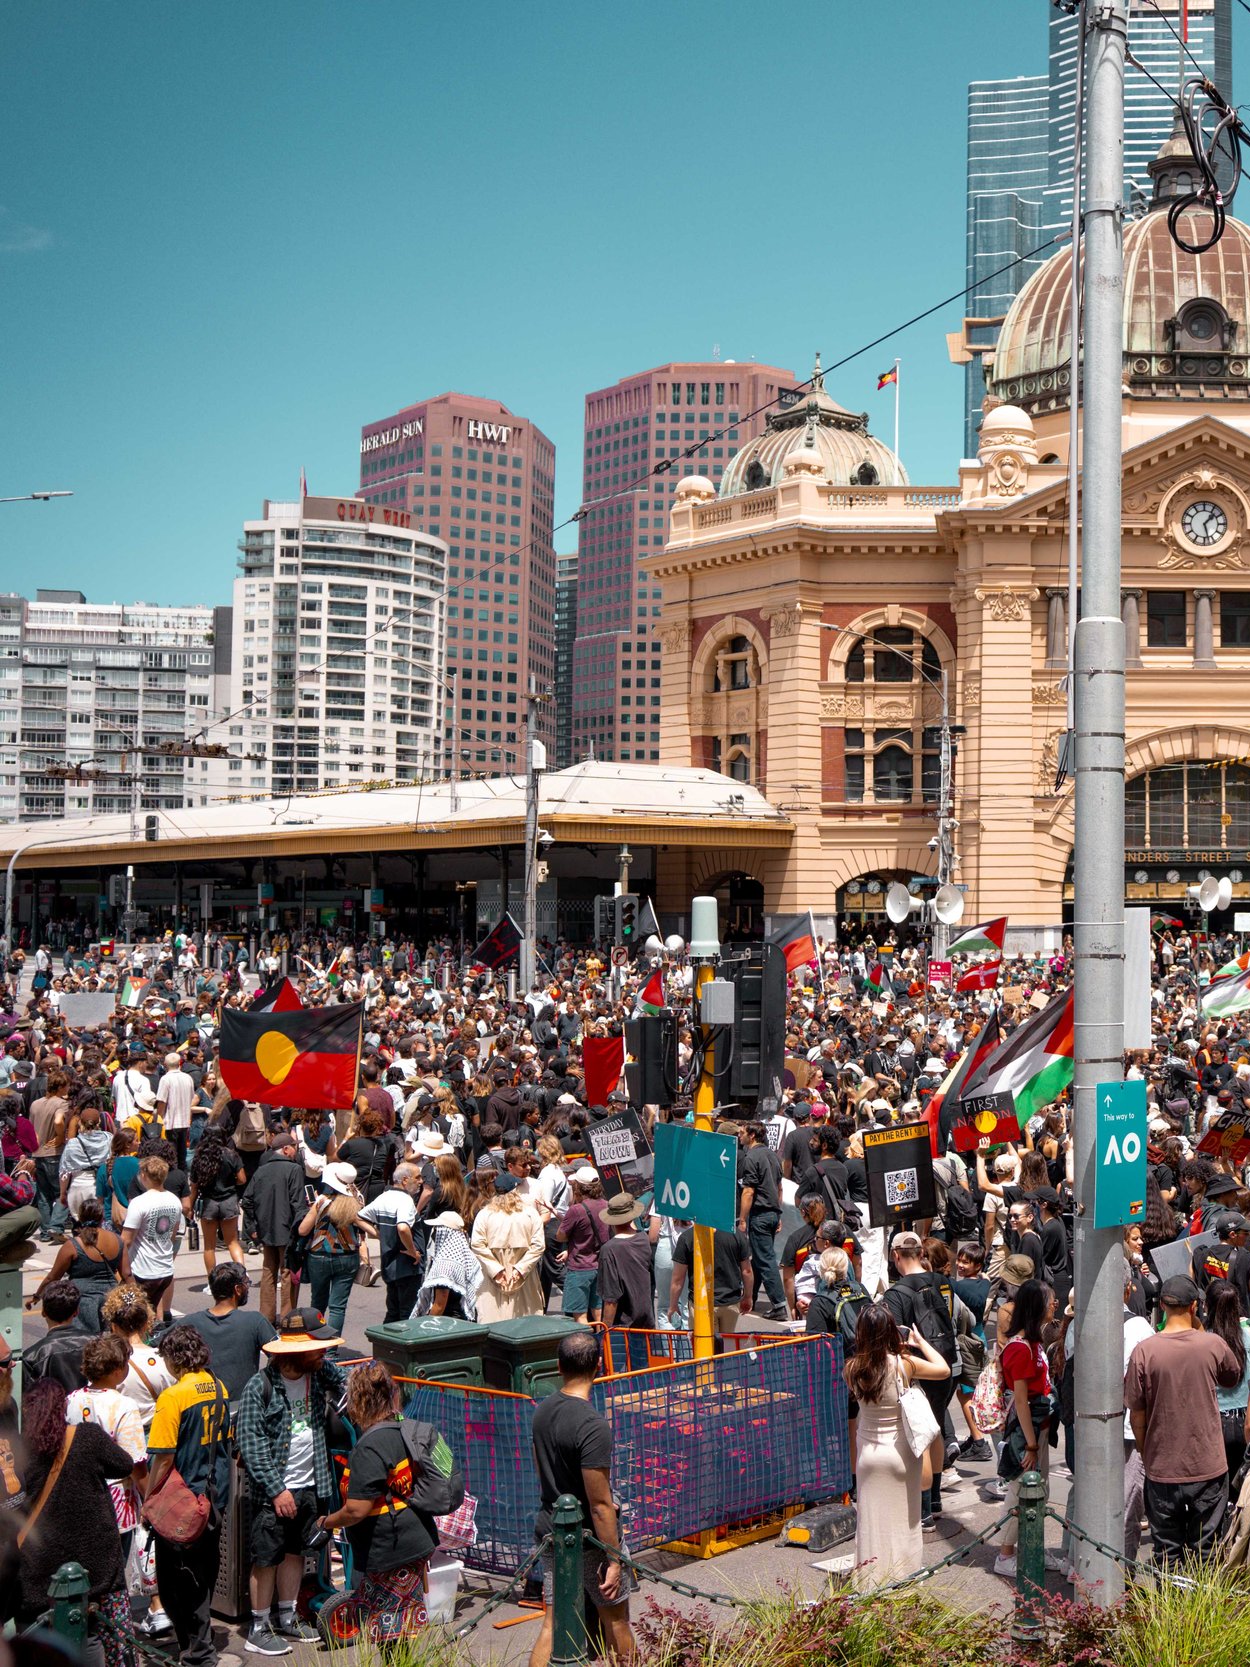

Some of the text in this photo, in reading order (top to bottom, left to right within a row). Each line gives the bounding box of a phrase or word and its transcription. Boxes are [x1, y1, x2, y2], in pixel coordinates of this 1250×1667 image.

[360, 418, 424, 453] HERALD SUN
[467, 419, 512, 443] HWT
[337, 502, 411, 528] QUAY WEST
[1185, 851, 1232, 862] STREET
[964, 1095, 999, 1114] FIRST
[1104, 1112, 1135, 1122] This way to
[588, 1117, 625, 1136] EVERYDAY
[869, 1127, 913, 1143] PAY THE RENT
[600, 1144, 631, 1161] NOW!
[195, 1381, 217, 1394] RODGE
